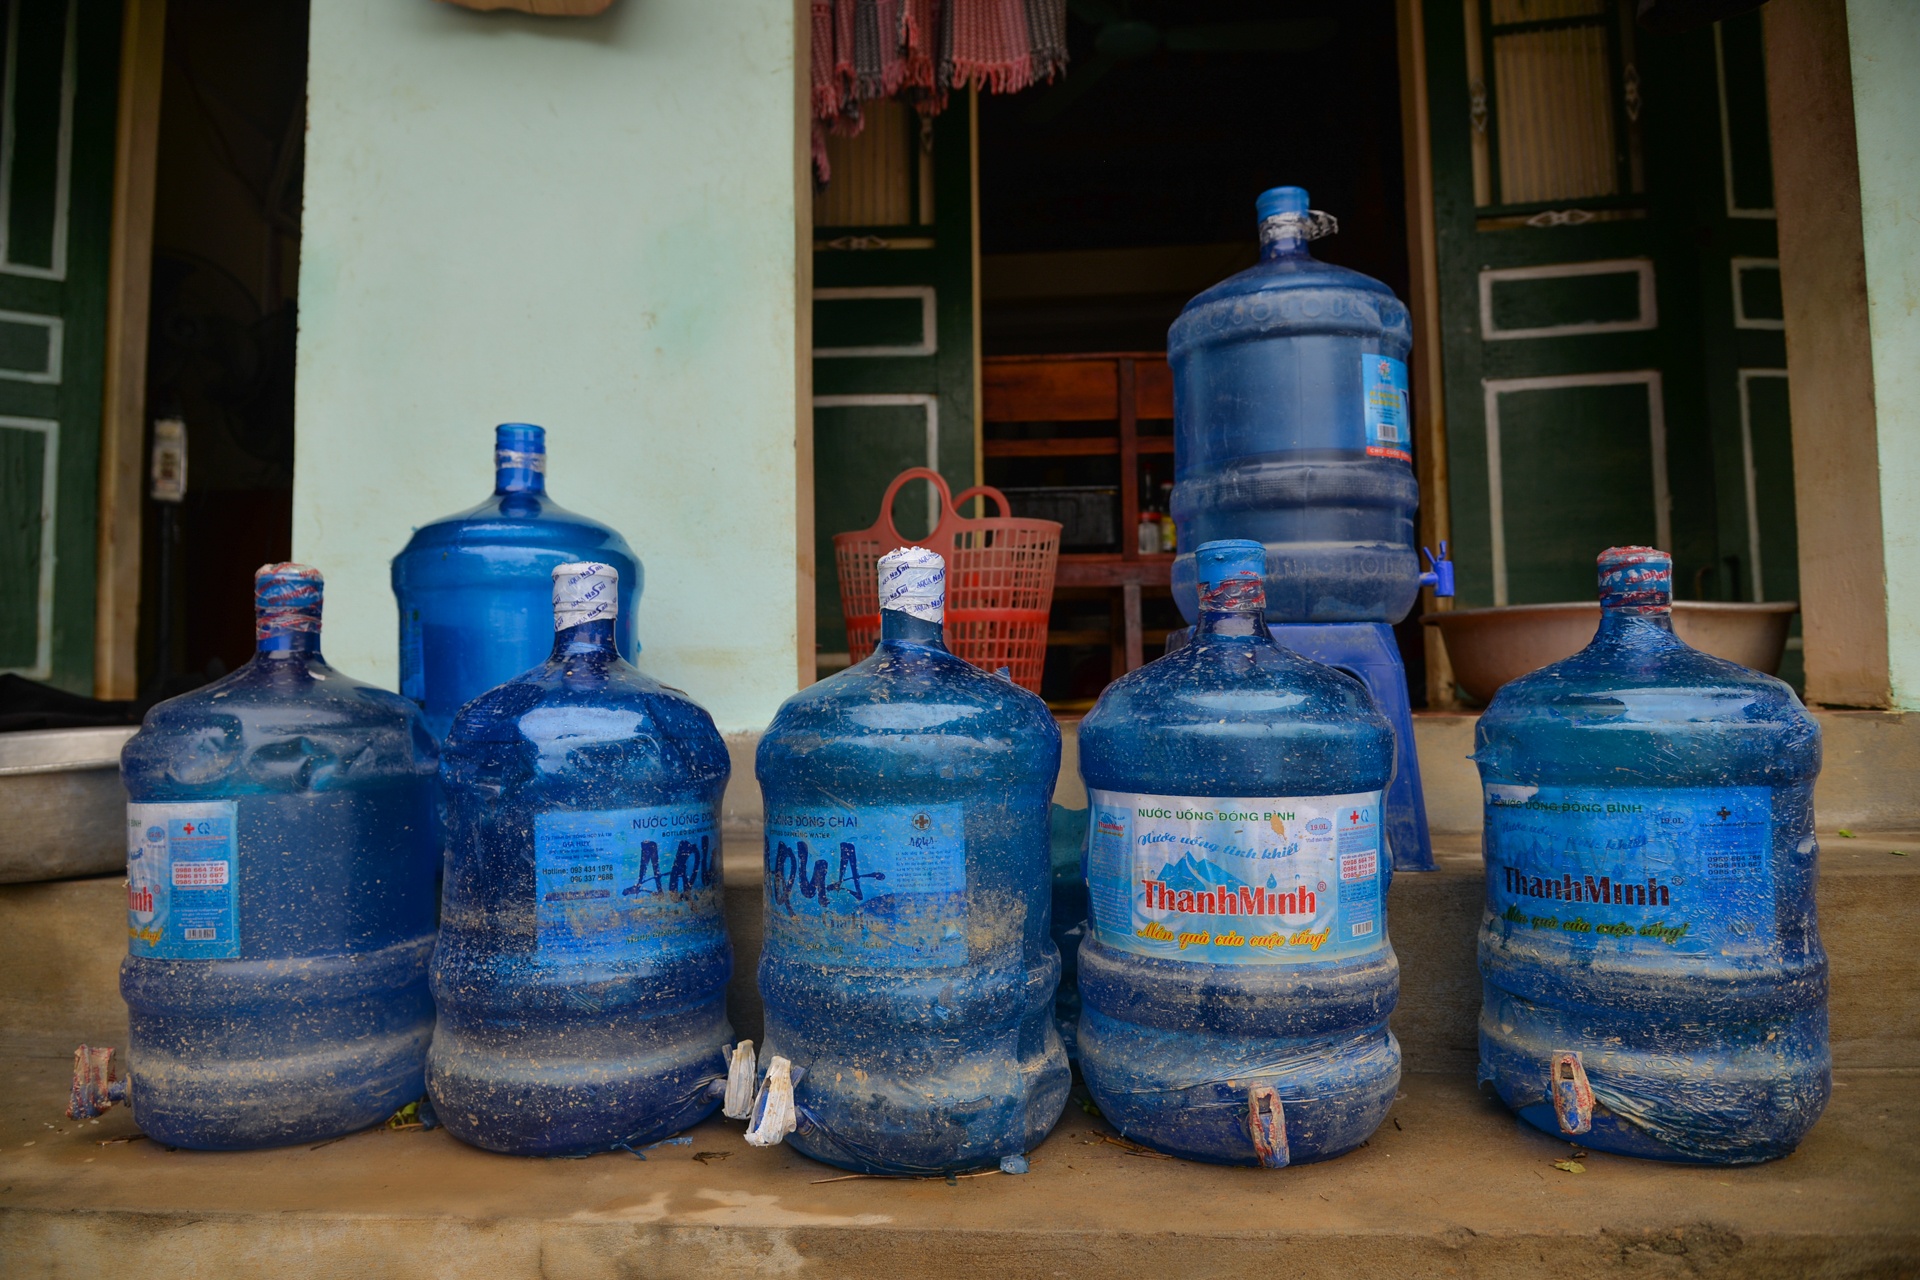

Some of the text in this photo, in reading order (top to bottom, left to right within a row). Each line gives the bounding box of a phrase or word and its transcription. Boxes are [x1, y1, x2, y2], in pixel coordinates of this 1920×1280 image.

[1606, 801, 1643, 813] BÌNH
[633, 815, 667, 829] NƯỚC
[671, 812, 700, 826] UỐNG
[795, 813, 825, 827] ĐÓNG
[828, 816, 858, 828] CHAI
[1138, 808, 1172, 819] NƯỚC
[1176, 808, 1214, 821] UỐNG
[1219, 810, 1259, 822] ĐÓNG
[1137, 830, 1176, 846] Nước
[542, 867, 569, 875] Hotline:
[1137, 921, 1175, 942] Món
[1178, 930, 1210, 951] quà
[1214, 930, 1245, 947] của
[1249, 932, 1286, 950] cuộc
